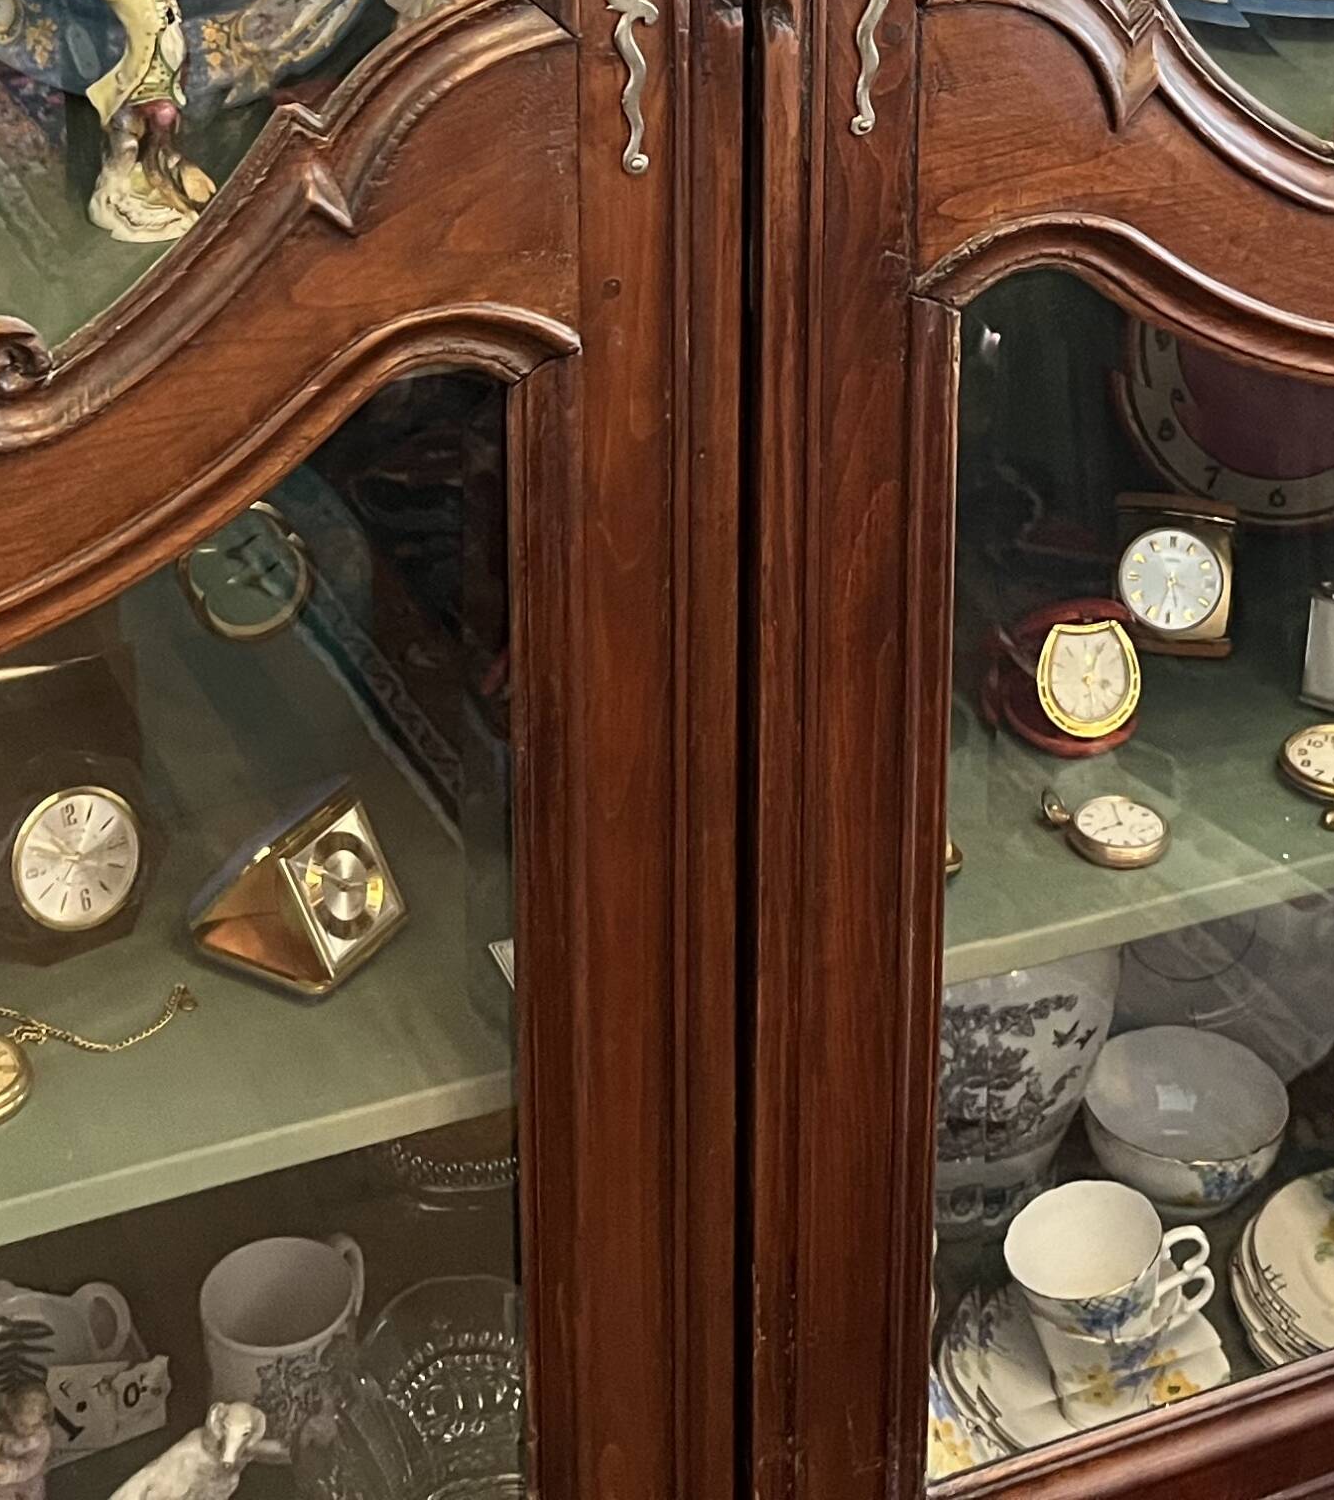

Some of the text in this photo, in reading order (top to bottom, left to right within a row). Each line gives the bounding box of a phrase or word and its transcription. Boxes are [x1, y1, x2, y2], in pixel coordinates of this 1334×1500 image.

[1204, 465, 1222, 491] 7
[1269, 484, 1286, 508] 6
[1307, 738, 1323, 748] 10
[1314, 768, 1325, 777] 7
[60, 803, 78, 828] 12
[80, 888, 92, 912] 6
